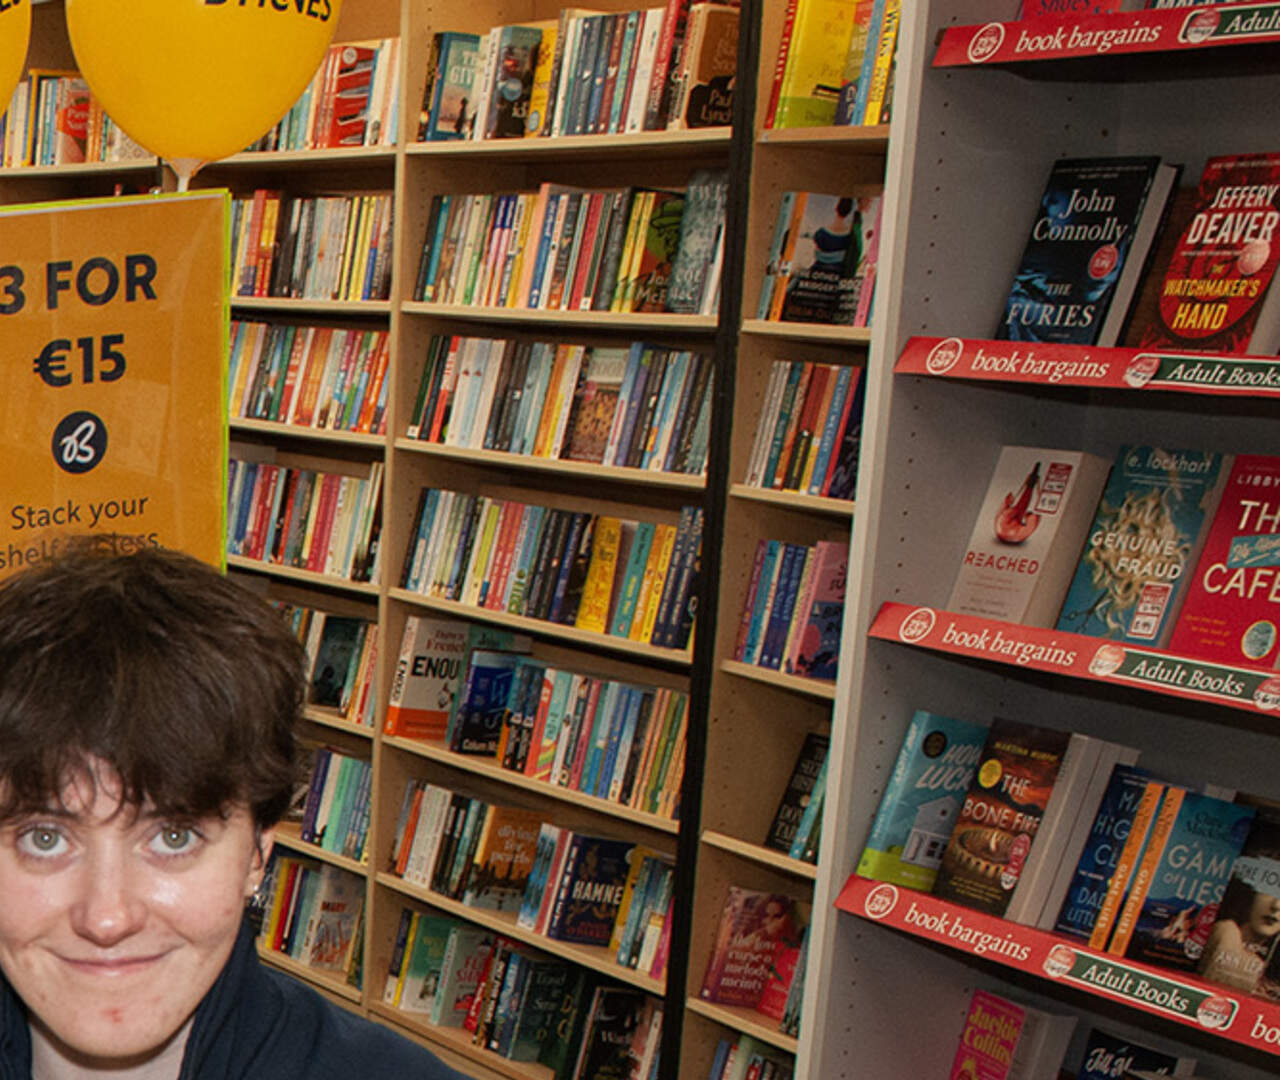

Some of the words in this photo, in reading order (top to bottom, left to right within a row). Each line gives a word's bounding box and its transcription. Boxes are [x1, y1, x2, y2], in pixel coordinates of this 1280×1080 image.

[1015, 26, 1068, 53] book
[1067, 20, 1162, 52] bargains
[1061, 189, 1115, 219] John
[1211, 186, 1279, 210] JEFFERY
[1033, 218, 1129, 243] Connolly
[1187, 212, 1280, 245] DEAVER
[45, 253, 158, 310] FOR
[1046, 283, 1072, 297] THE
[1164, 279, 1261, 298] WATCHMAKER'S
[1005, 304, 1096, 328] FURIES
[1172, 304, 1228, 330] HAND
[33, 333, 128, 388] €15
[970, 349, 1020, 373] book
[1020, 352, 1110, 383] bargains
[1166, 362, 1224, 385] Adult
[1146, 448, 1212, 475] lockhart
[11, 499, 81, 531] Stack
[88, 495, 149, 529] your
[1091, 531, 1178, 556] GENUINE
[964, 550, 1040, 575] REACHED
[1116, 558, 1184, 581] FRAUD
[942, 624, 987, 651] book
[990, 630, 1078, 667] bargains
[1129, 659, 1189, 687] Adult
[1188, 670, 1245, 697] Books
[1001, 773, 1032, 798] THE
[962, 799, 1009, 827] BONE
[904, 902, 948, 934] book
[950, 917, 1030, 962] bargains
[1081, 962, 1132, 997] Adult
[1136, 979, 1190, 1013] Books
[969, 1005, 1021, 1042] Jackie
